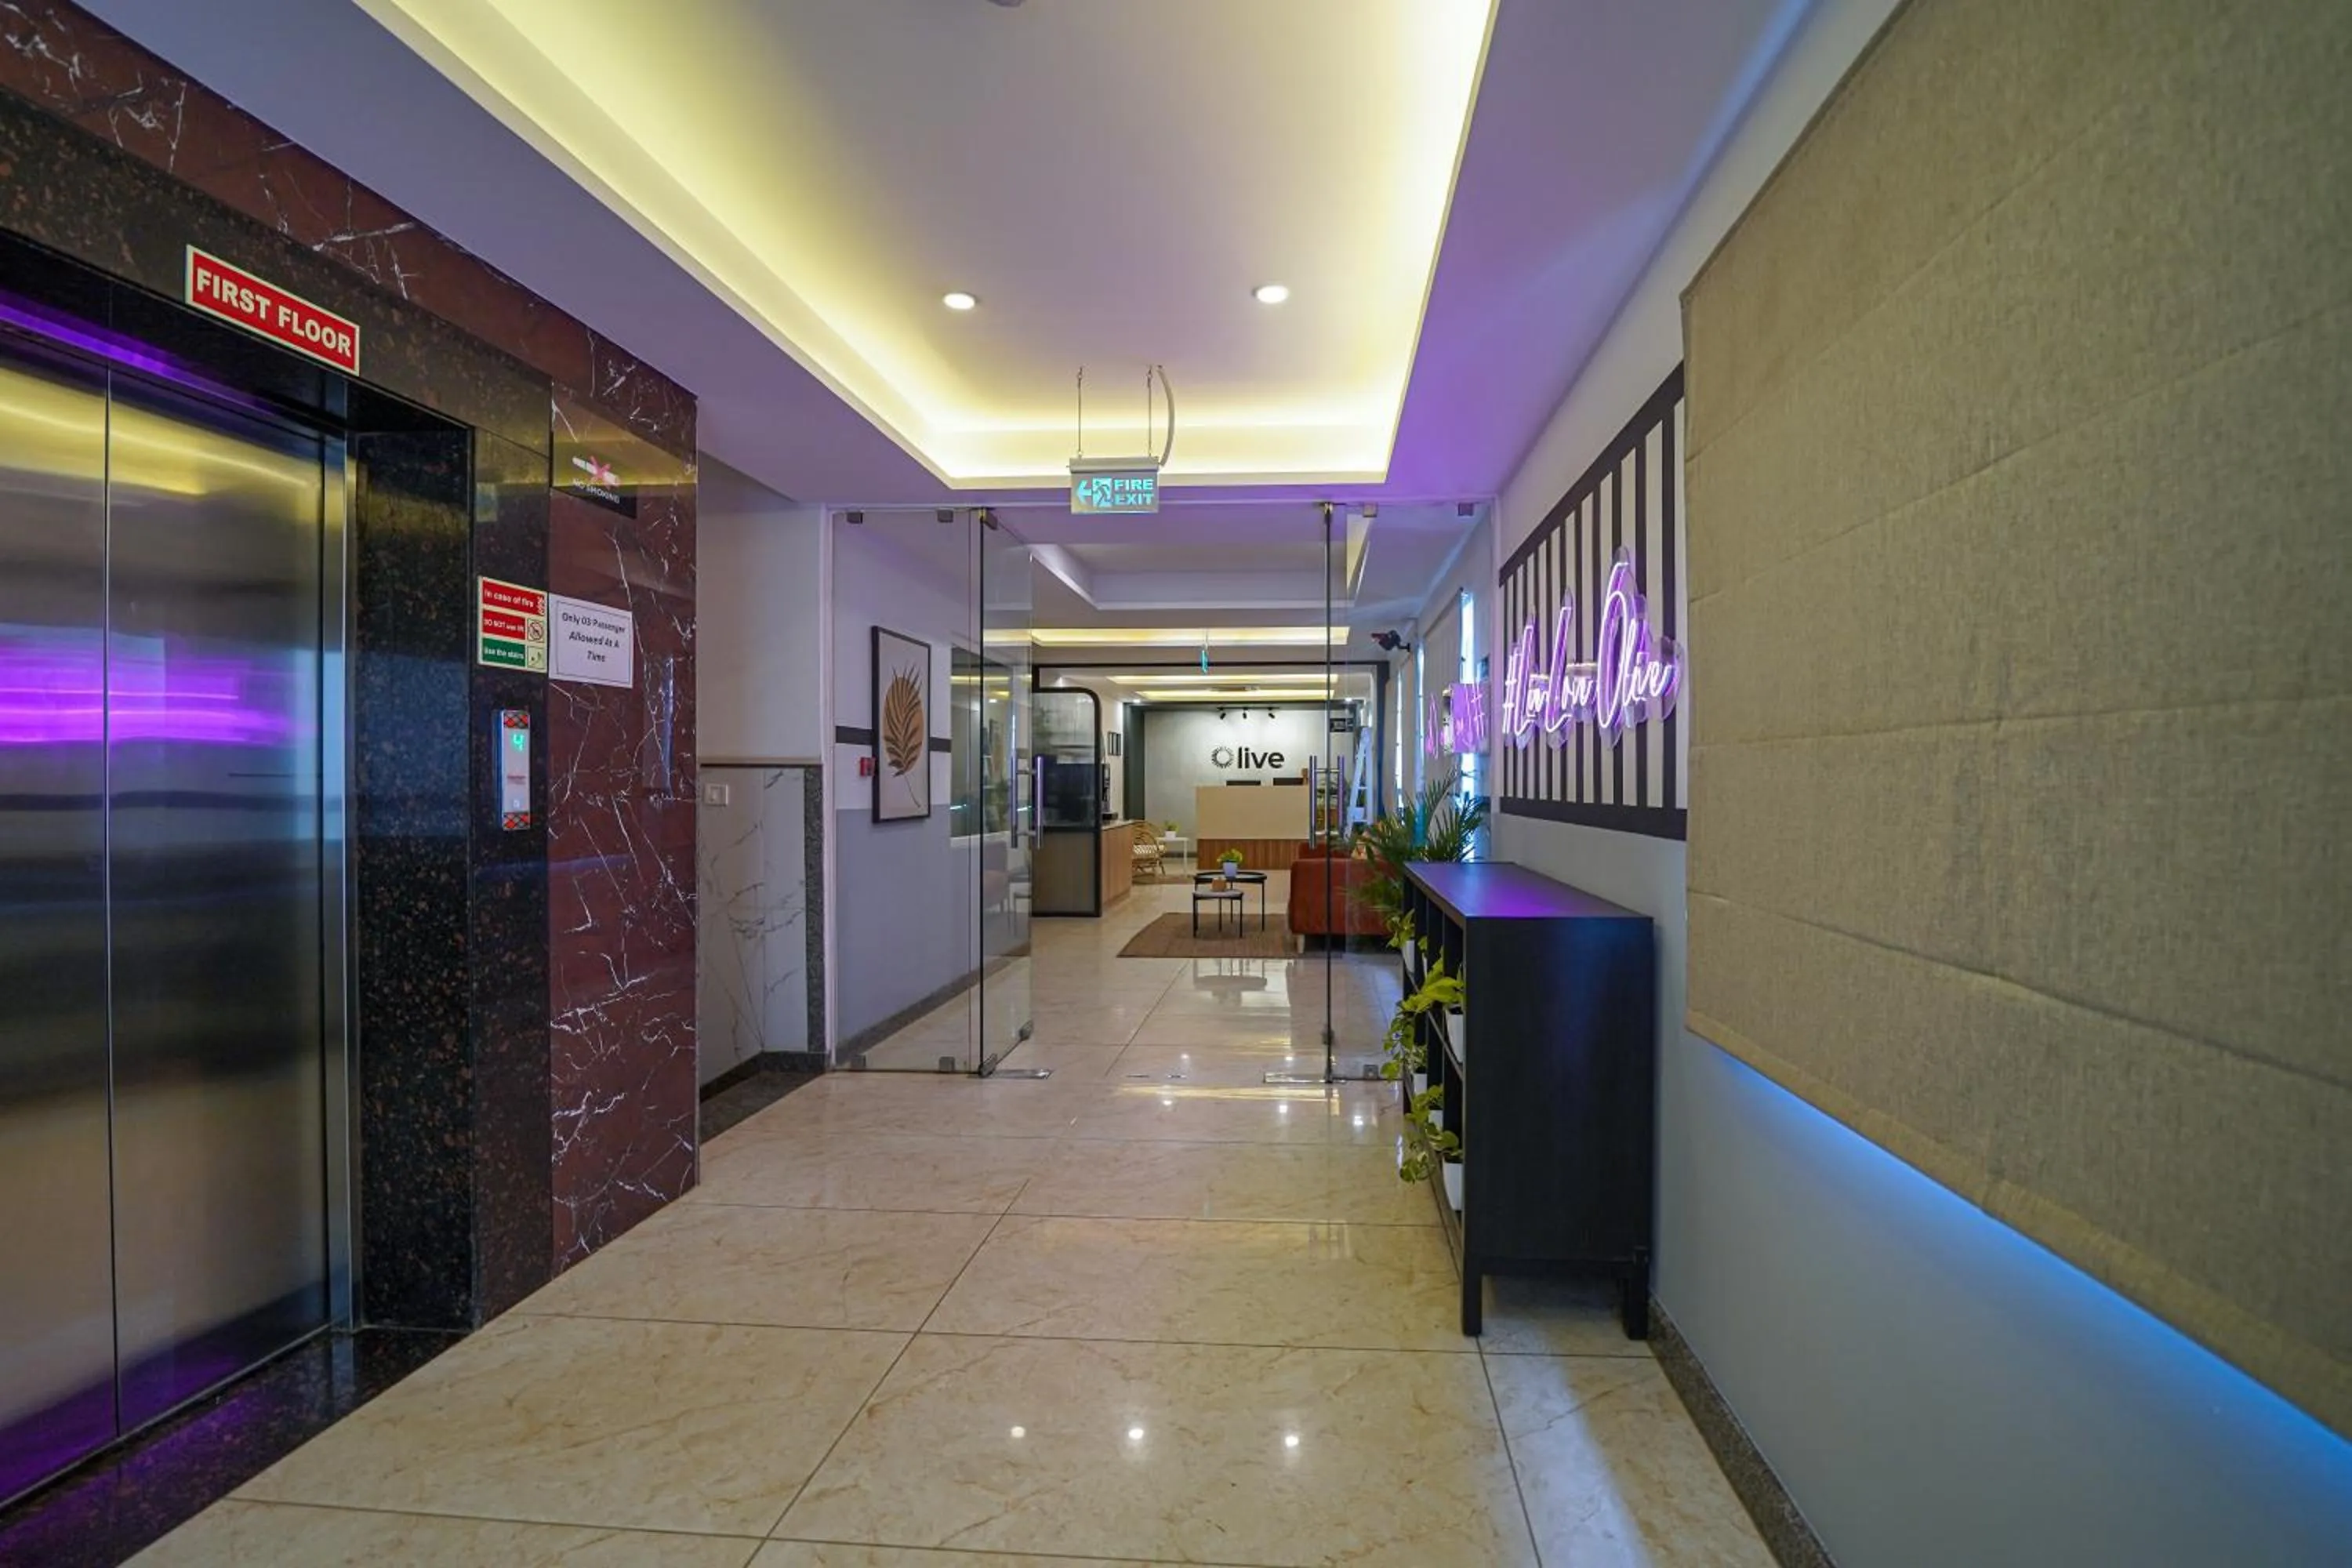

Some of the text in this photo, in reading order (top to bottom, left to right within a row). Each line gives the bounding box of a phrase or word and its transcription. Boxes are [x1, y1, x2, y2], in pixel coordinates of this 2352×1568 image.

[196, 267, 351, 358] FIRST FLOOR
[1114, 479, 1154, 490] FIRE
[1114, 493, 1154, 505] EXIT
[484, 589, 534, 608] In case of fire
[484, 618, 493, 627] DO
[493, 619, 506, 629] NOT
[561, 612, 626, 634] Only 03 Passenger
[568, 631, 620, 648] Allowed At A
[484, 646, 524, 660] Use the stairs
[586, 650, 606, 663] Time
[513, 733, 524, 752] 4
[1210, 746, 1285, 769] Olive
